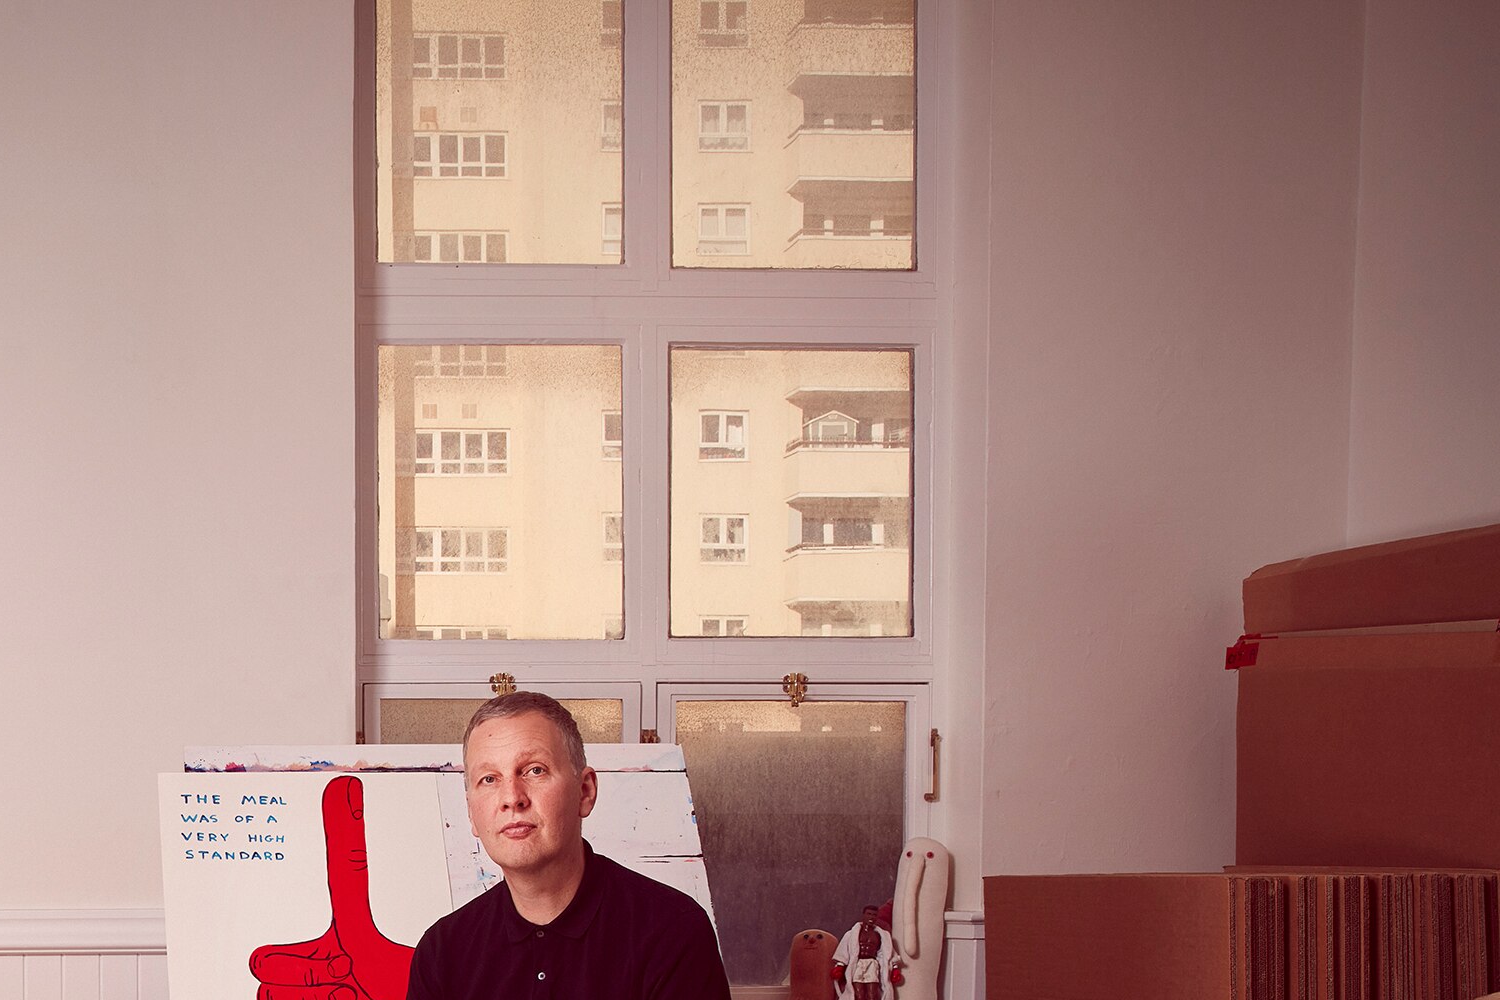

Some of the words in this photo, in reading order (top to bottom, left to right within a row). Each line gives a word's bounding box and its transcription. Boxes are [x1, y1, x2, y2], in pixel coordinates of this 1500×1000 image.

[181, 794, 220, 805] THE
[241, 795, 287, 805] MEAL
[180, 814, 218, 823] WAS
[234, 815, 254, 823] OF
[267, 815, 277, 823] A
[181, 832, 229, 842] VERY
[248, 834, 285, 843] HIGH
[185, 849, 285, 860] STANDARD
